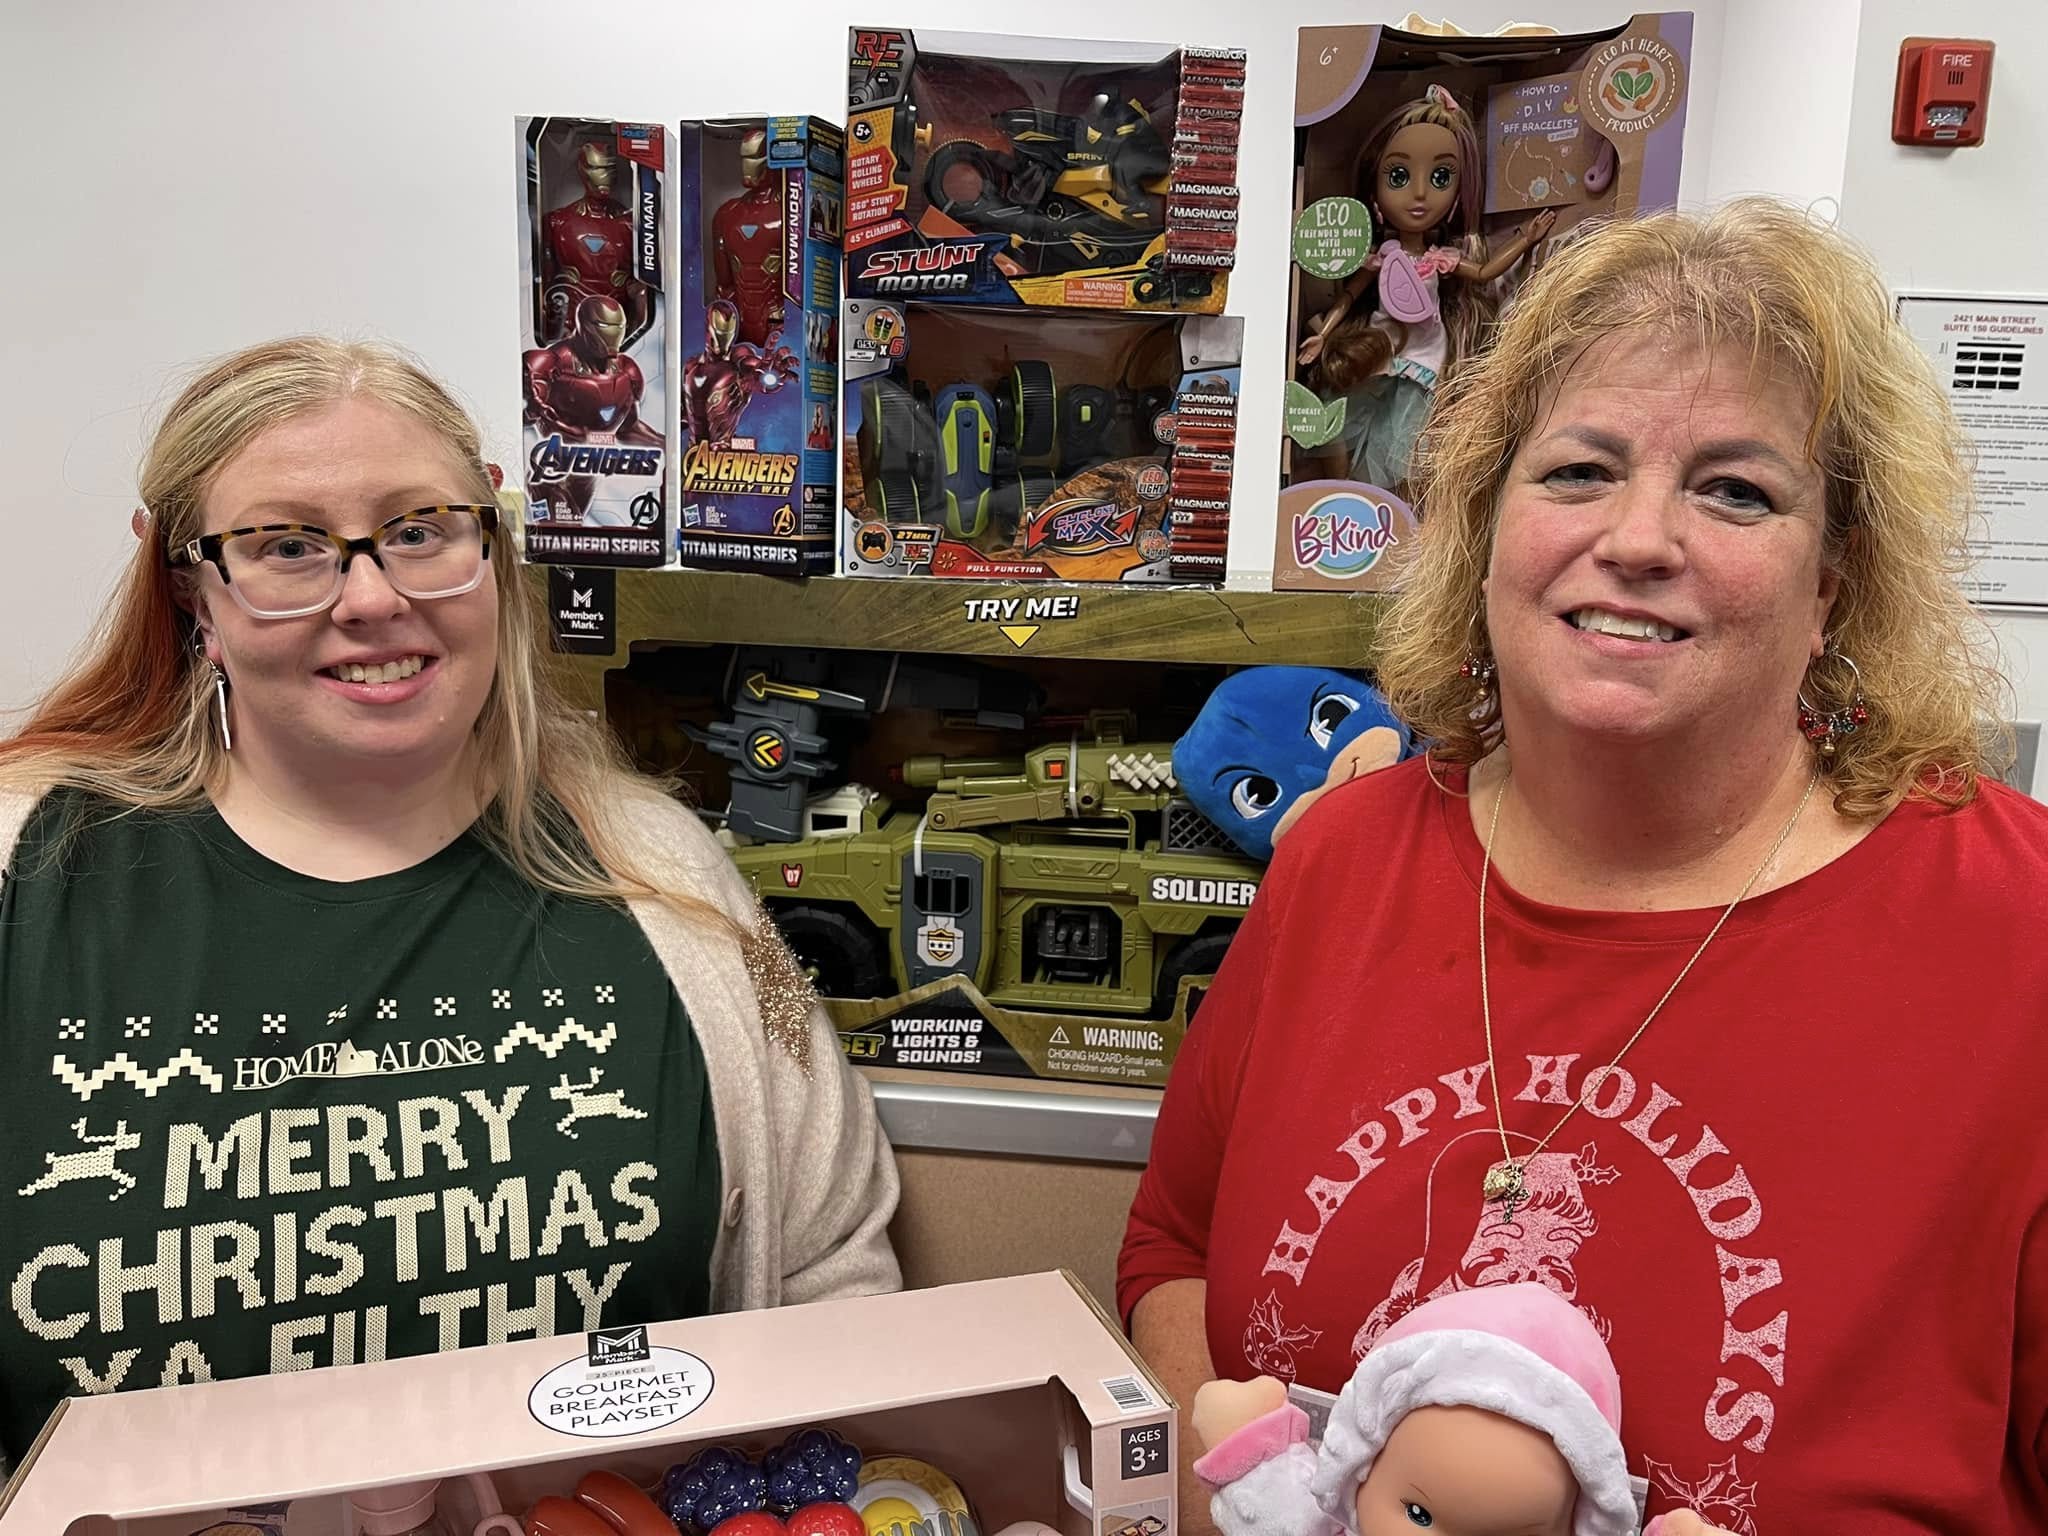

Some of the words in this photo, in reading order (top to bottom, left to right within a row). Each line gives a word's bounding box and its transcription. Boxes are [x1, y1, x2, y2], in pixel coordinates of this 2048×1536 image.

[1597, 46, 1618, 66] ECO
[1621, 37, 1637, 53] AT
[1638, 38, 1673, 62] HEART
[1941, 54, 1974, 67] FIRE
[1521, 85, 1546, 96] HOW
[1548, 84, 1560, 94] TO
[1504, 123, 1520, 133] BFF
[1522, 119, 1573, 132] BRACELETS
[1605, 112, 1655, 133] PRODUCT
[856, 125, 871, 137] 5+
[852, 154, 880, 168] ROTARY
[852, 165, 882, 179] ROLLING
[852, 176, 882, 189] WHEELS
[1175, 184, 1238, 195] MAGNAVOX
[871, 194, 894, 206] STUNT
[644, 192, 655, 230] MAN
[853, 207, 888, 221] ROTATION
[1174, 207, 1237, 220] MAGNAVOX
[1316, 201, 1350, 227] ECO
[865, 221, 902, 239] CLIMBING
[1343, 228, 1362, 237] DOLL
[644, 232, 655, 270] IRON
[858, 243, 985, 279] STUNT
[1170, 253, 1233, 266] MAGNAVOX
[876, 274, 968, 292] MOTOR
[1083, 281, 1125, 291] WARNING:
[1953, 314, 1974, 322] 2421
[1976, 315, 1999, 323] MAIN
[2001, 316, 2036, 325] STREET
[1943, 324, 1969, 332] SUITE
[1989, 325, 2044, 334] GUIDELINES
[530, 435, 662, 482] AVENGERS
[683, 440, 799, 491] AVENGERS
[693, 482, 755, 492] INFINITY
[761, 485, 792, 496] WAR
[1174, 498, 1229, 509] MAGNAVOX
[1053, 503, 1116, 529] CYCLONE
[1056, 513, 1124, 544] MAX
[531, 536, 571, 550] TITAN
[573, 537, 609, 552] HERO
[612, 538, 660, 554] SERIES
[682, 541, 716, 556] TITAN
[718, 543, 751, 560] HERO
[753, 546, 797, 563] SERIES
[994, 564, 1043, 574] FUNCTION
[560, 610, 604, 621] Member's
[965, 598, 1019, 620] TRY
[1025, 597, 1079, 619] ME!
[787, 870, 800, 883] 07
[1152, 877, 1257, 905] SOLDIER
[891, 1019, 983, 1033] WORKING
[892, 1035, 960, 1048] LIGHTS
[964, 1035, 979, 1048] &
[1083, 1026, 1163, 1051] WARNING:
[897, 1050, 982, 1063] SOUNDS!
[1047, 1048, 1086, 1061] CHOKING
[233, 1042, 338, 1090] HOME
[1047, 1061, 1060, 1070] Not
[1061, 1061, 1071, 1071] for
[1072, 1063, 1099, 1073] children
[1101, 1065, 1120, 1074] under
[1121, 1066, 1126, 1075] 3
[164, 1085, 529, 1209] MERRY
[11, 1161, 661, 1341] CHRISTMAS
[1260, 1060, 1491, 1287] HAPPY
[1513, 1053, 1789, 1453] HOLIDAYS
[592, 1349, 646, 1361] Member's
[553, 1371, 689, 1399] GOURMET
[550, 1385, 696, 1415] BREAKFAST
[572, 1403, 679, 1428] PLAYSET
[1128, 1429, 1160, 1445] AGES
[1131, 1446, 1159, 1471] 3+
